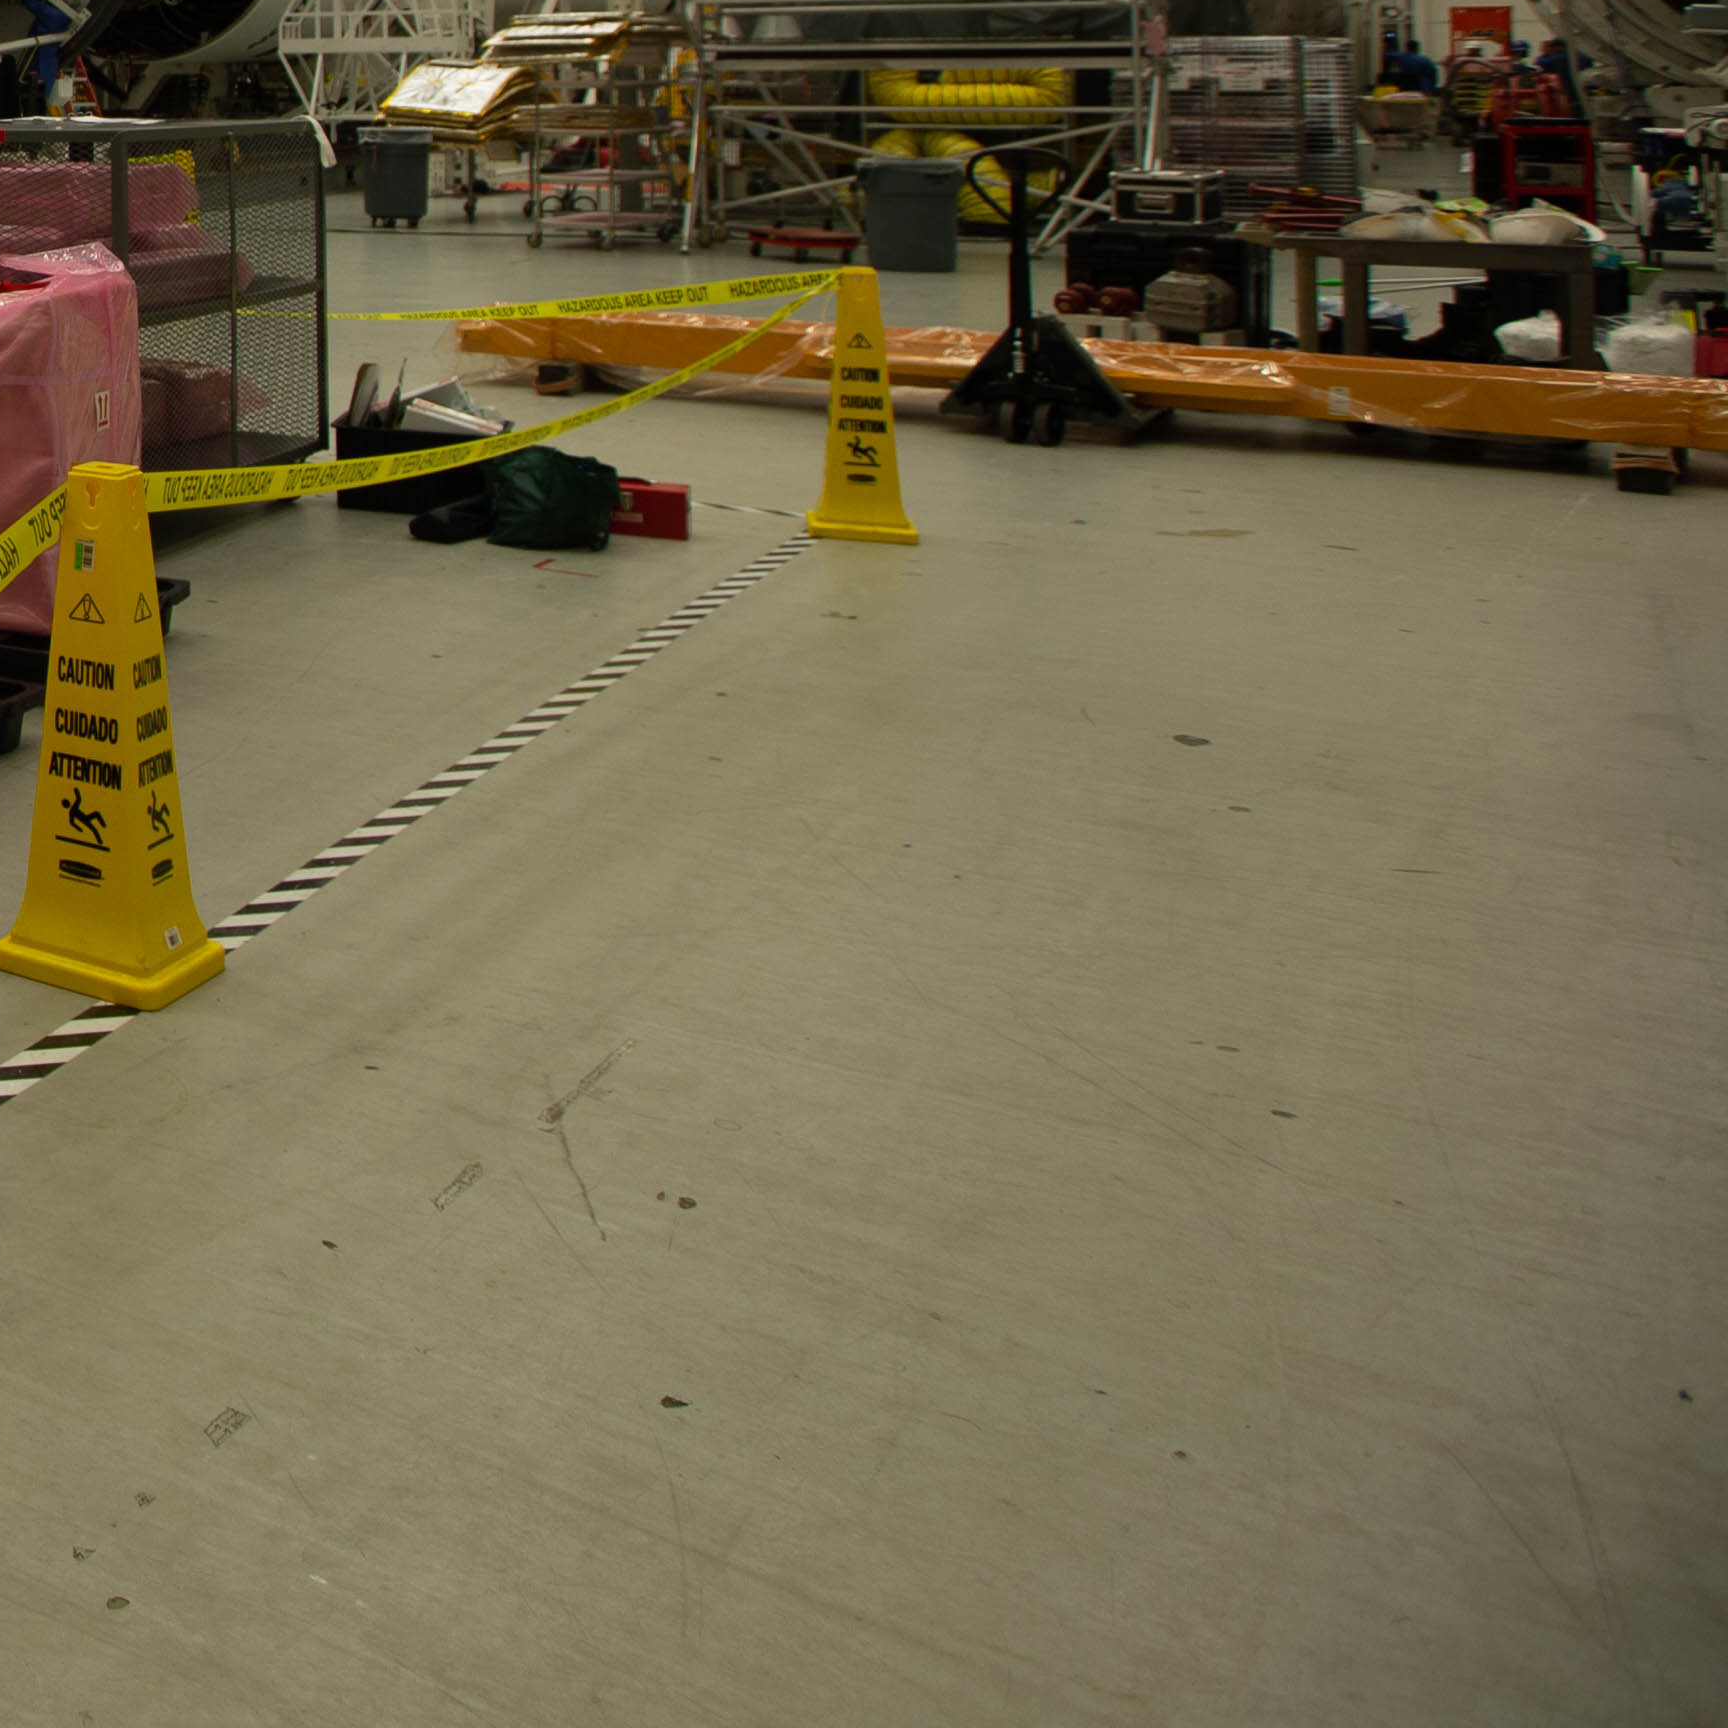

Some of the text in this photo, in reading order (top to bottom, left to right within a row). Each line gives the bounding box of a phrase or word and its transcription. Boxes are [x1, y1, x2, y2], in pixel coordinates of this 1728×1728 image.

[558, 286, 708, 314] HAZARDOUS AREA KEEP OUT
[729, 275, 801, 297] HAZARDOUS
[841, 367, 880, 383] CAUTION
[839, 394, 883, 411] CUIDADO
[838, 418, 888, 435] ATTENTION
[57, 656, 115, 691] CAUTION
[132, 653, 162, 689] CAUTION
[55, 707, 118, 745] CUIDADO
[136, 706, 168, 743] CUIDADO
[49, 751, 122, 791] ATTENTION
[138, 749, 174, 789] ATTENTION
